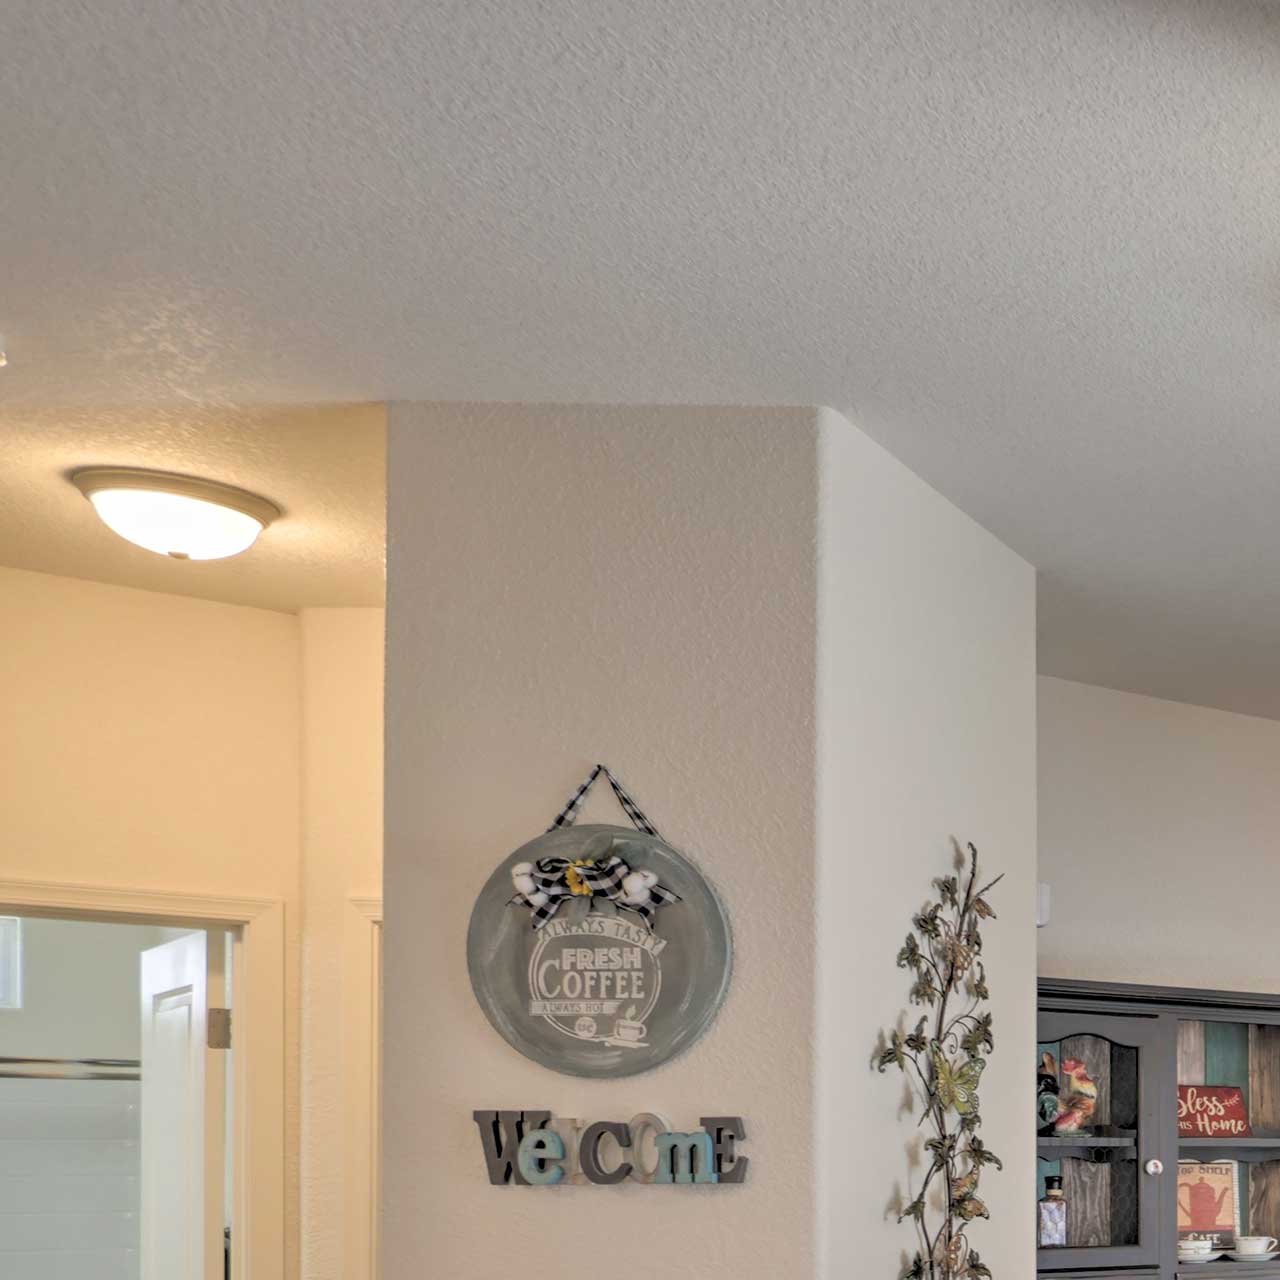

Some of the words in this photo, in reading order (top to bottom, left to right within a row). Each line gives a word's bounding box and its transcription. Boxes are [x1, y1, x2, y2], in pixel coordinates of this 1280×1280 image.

[614, 922, 662, 953] TASTY
[562, 947, 642, 970] FRESH
[538, 958, 645, 999] COFFEE
[543, 1002, 583, 1014] ALWAYS
[585, 1002, 605, 1014] HOT
[1196, 1112, 1247, 1136] Home
